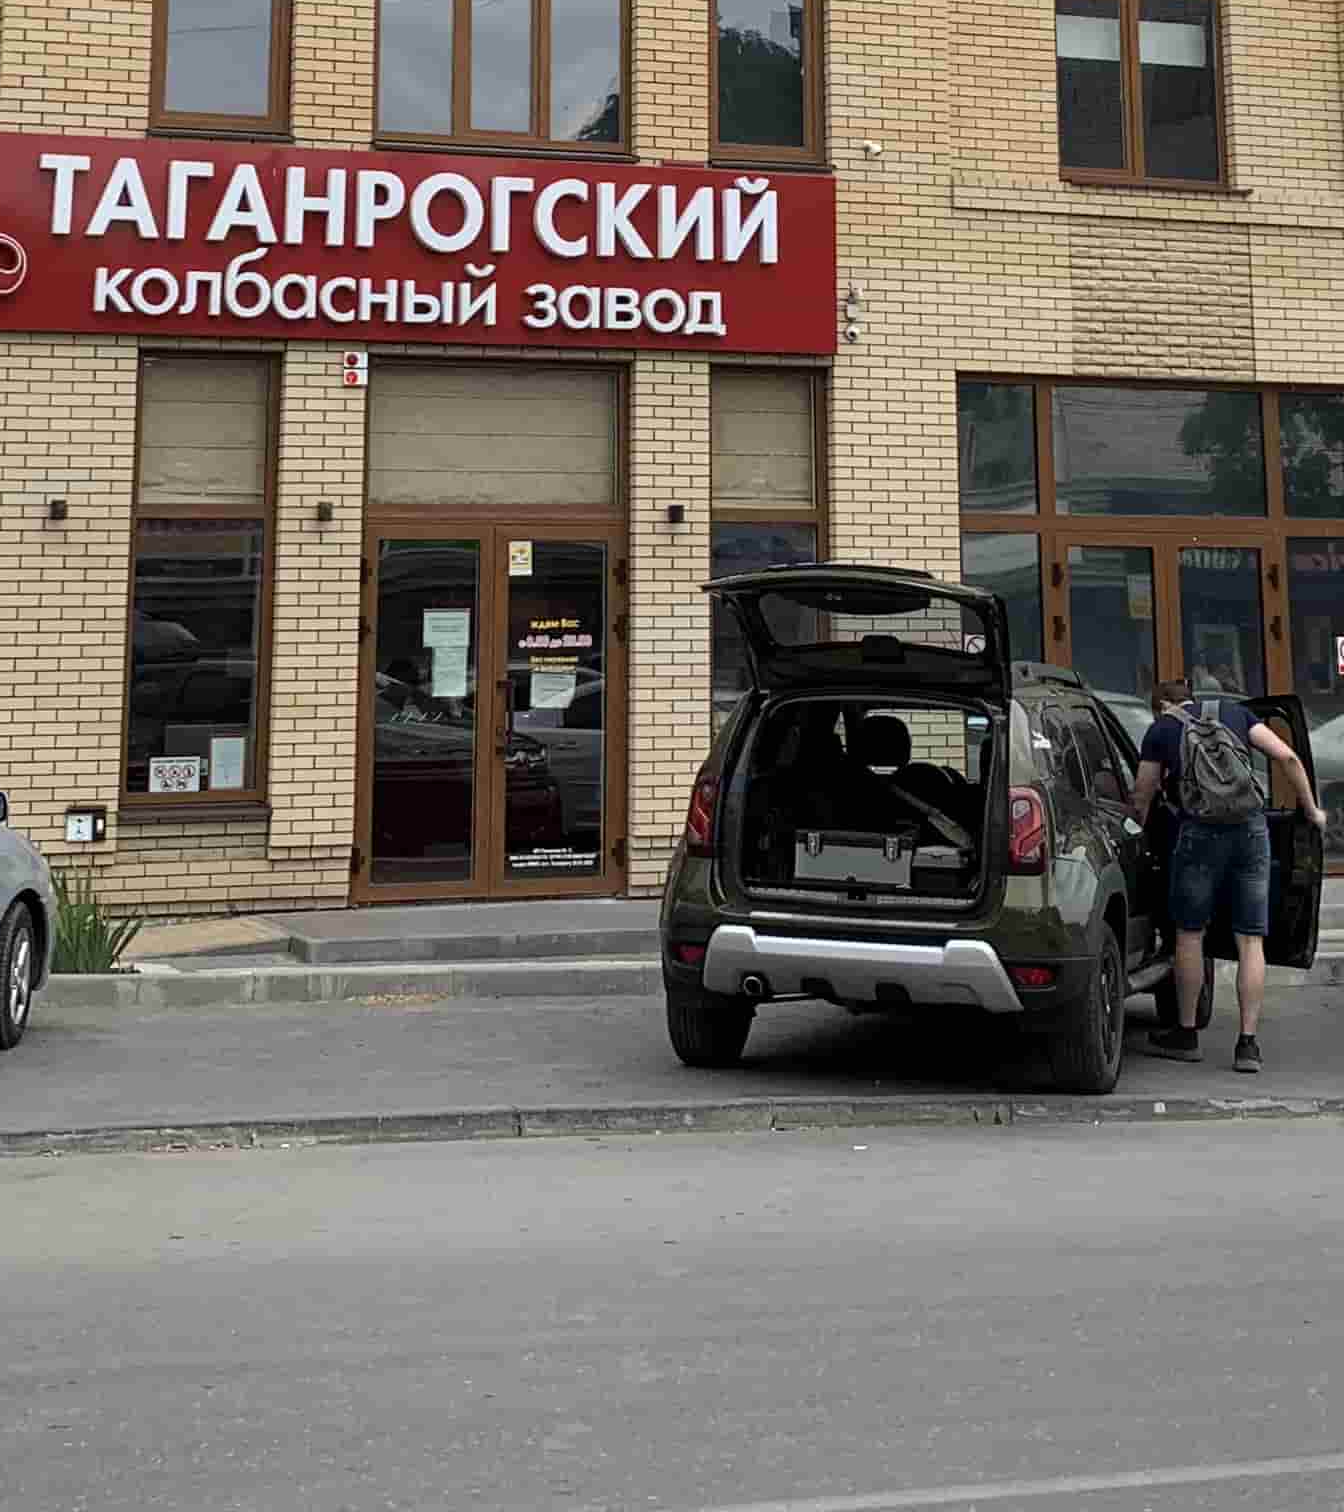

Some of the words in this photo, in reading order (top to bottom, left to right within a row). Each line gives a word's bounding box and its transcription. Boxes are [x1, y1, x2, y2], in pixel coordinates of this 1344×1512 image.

[38, 152, 779, 264] ТАГАНРОГСКИЙ
[92, 247, 497, 326] колбасный
[522, 283, 727, 336] завод
